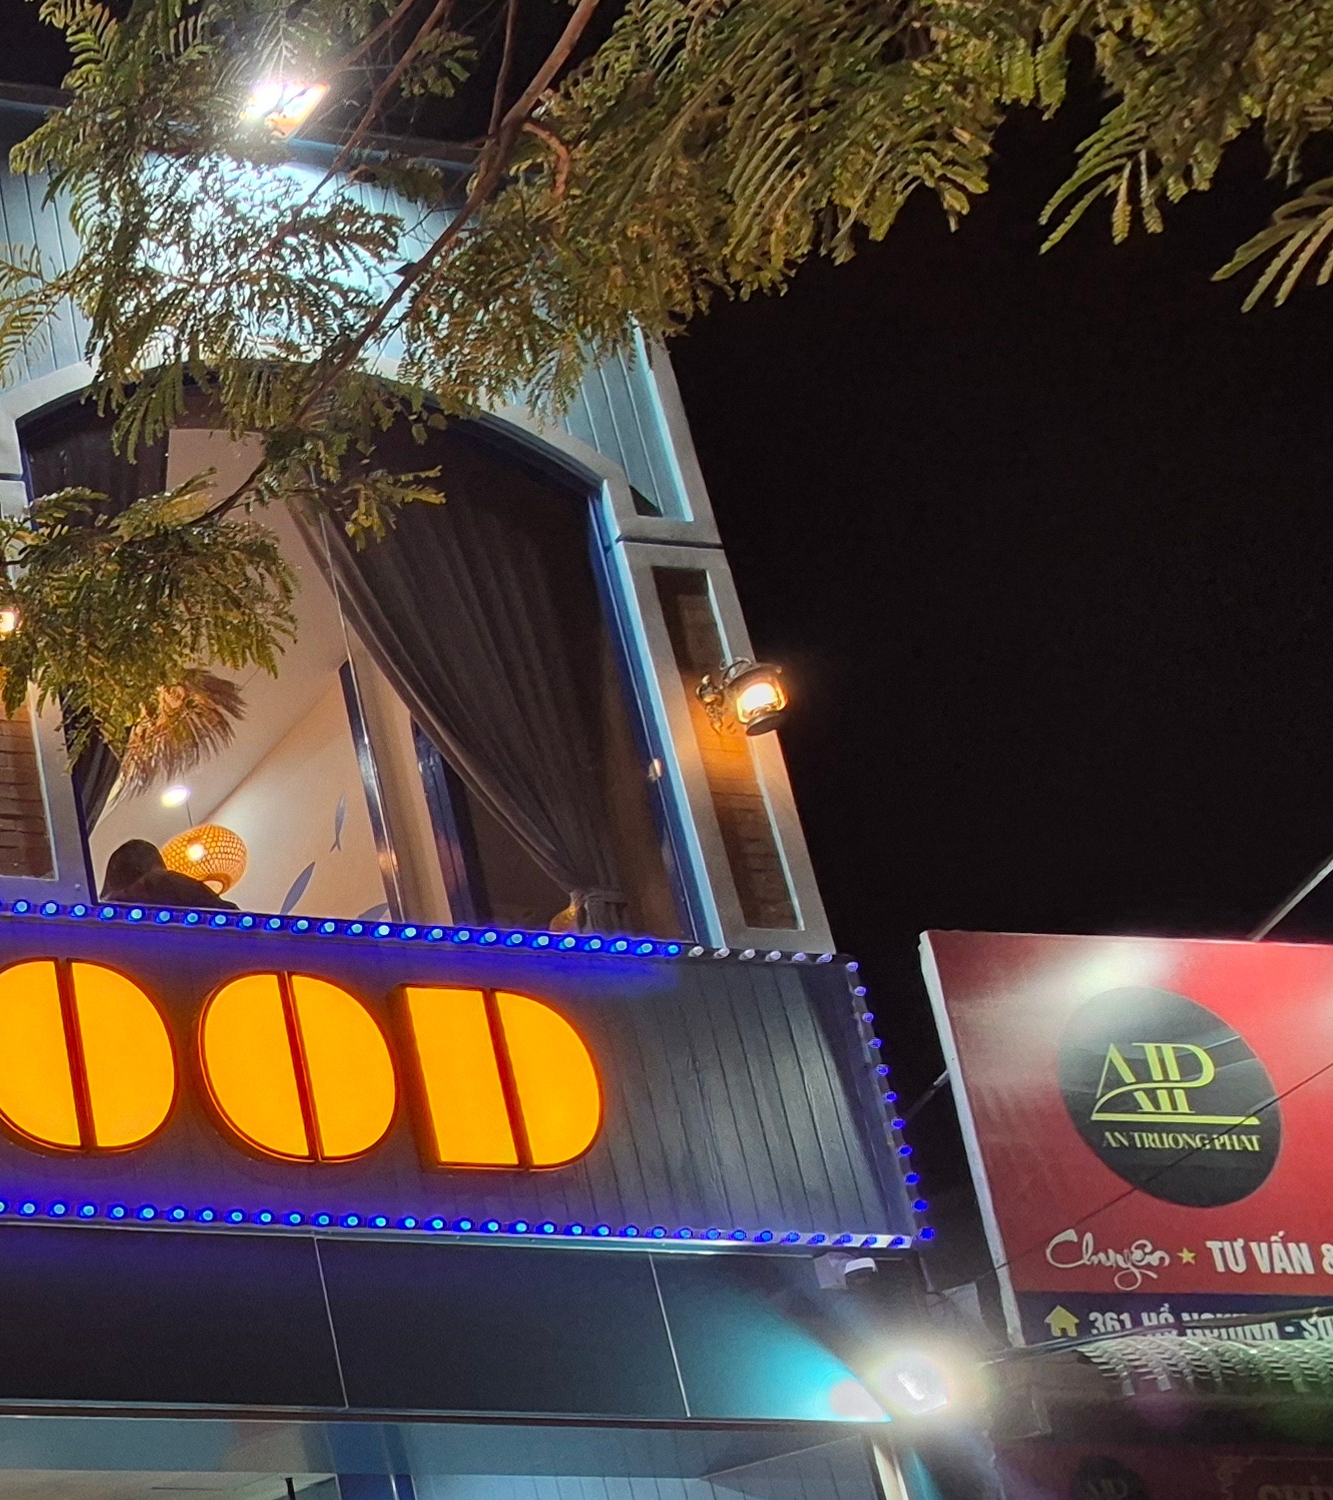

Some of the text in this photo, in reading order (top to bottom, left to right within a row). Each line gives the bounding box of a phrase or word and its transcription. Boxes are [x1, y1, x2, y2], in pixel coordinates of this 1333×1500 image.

[1046, 1229, 1169, 1290] Chuyên
[1206, 1238, 1247, 1273] TƯ
[1248, 1230, 1315, 1275] VẤN
[1088, 1312, 1133, 1335] 361
